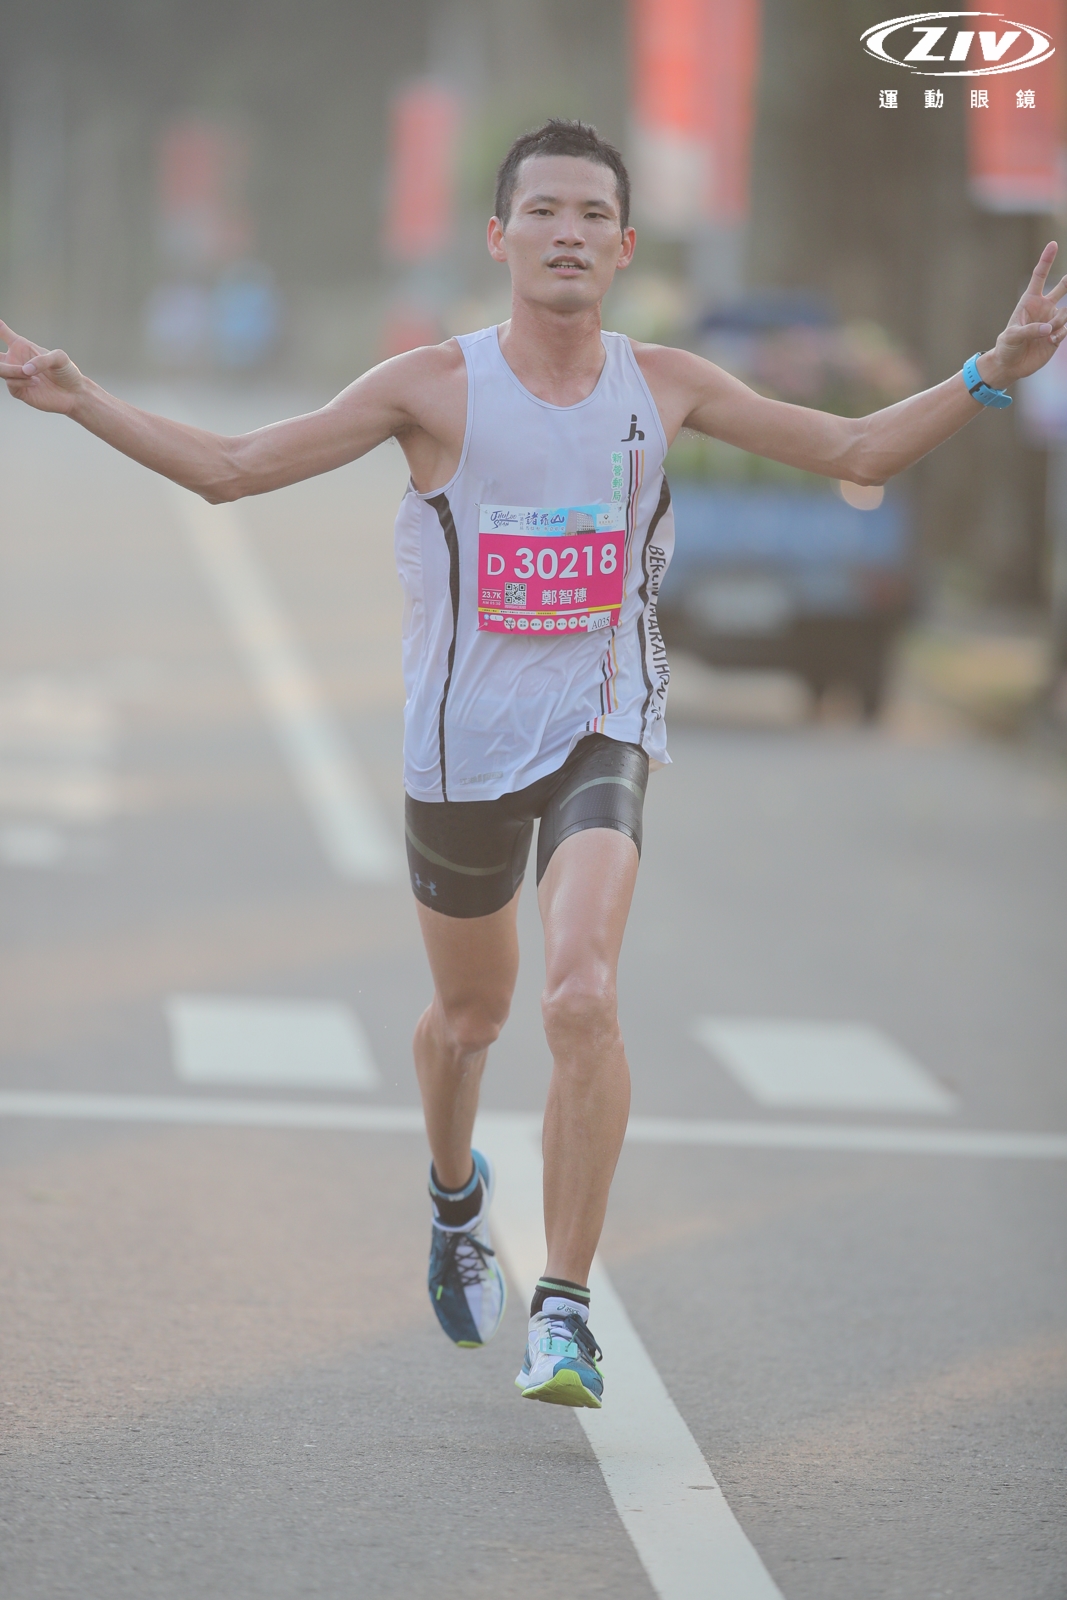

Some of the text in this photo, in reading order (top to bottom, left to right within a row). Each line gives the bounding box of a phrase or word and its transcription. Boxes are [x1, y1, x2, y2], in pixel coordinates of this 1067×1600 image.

[487, 543, 617, 580] D 30218
[482, 591, 502, 600] 23.7K
[591, 617, 611, 630] A035
